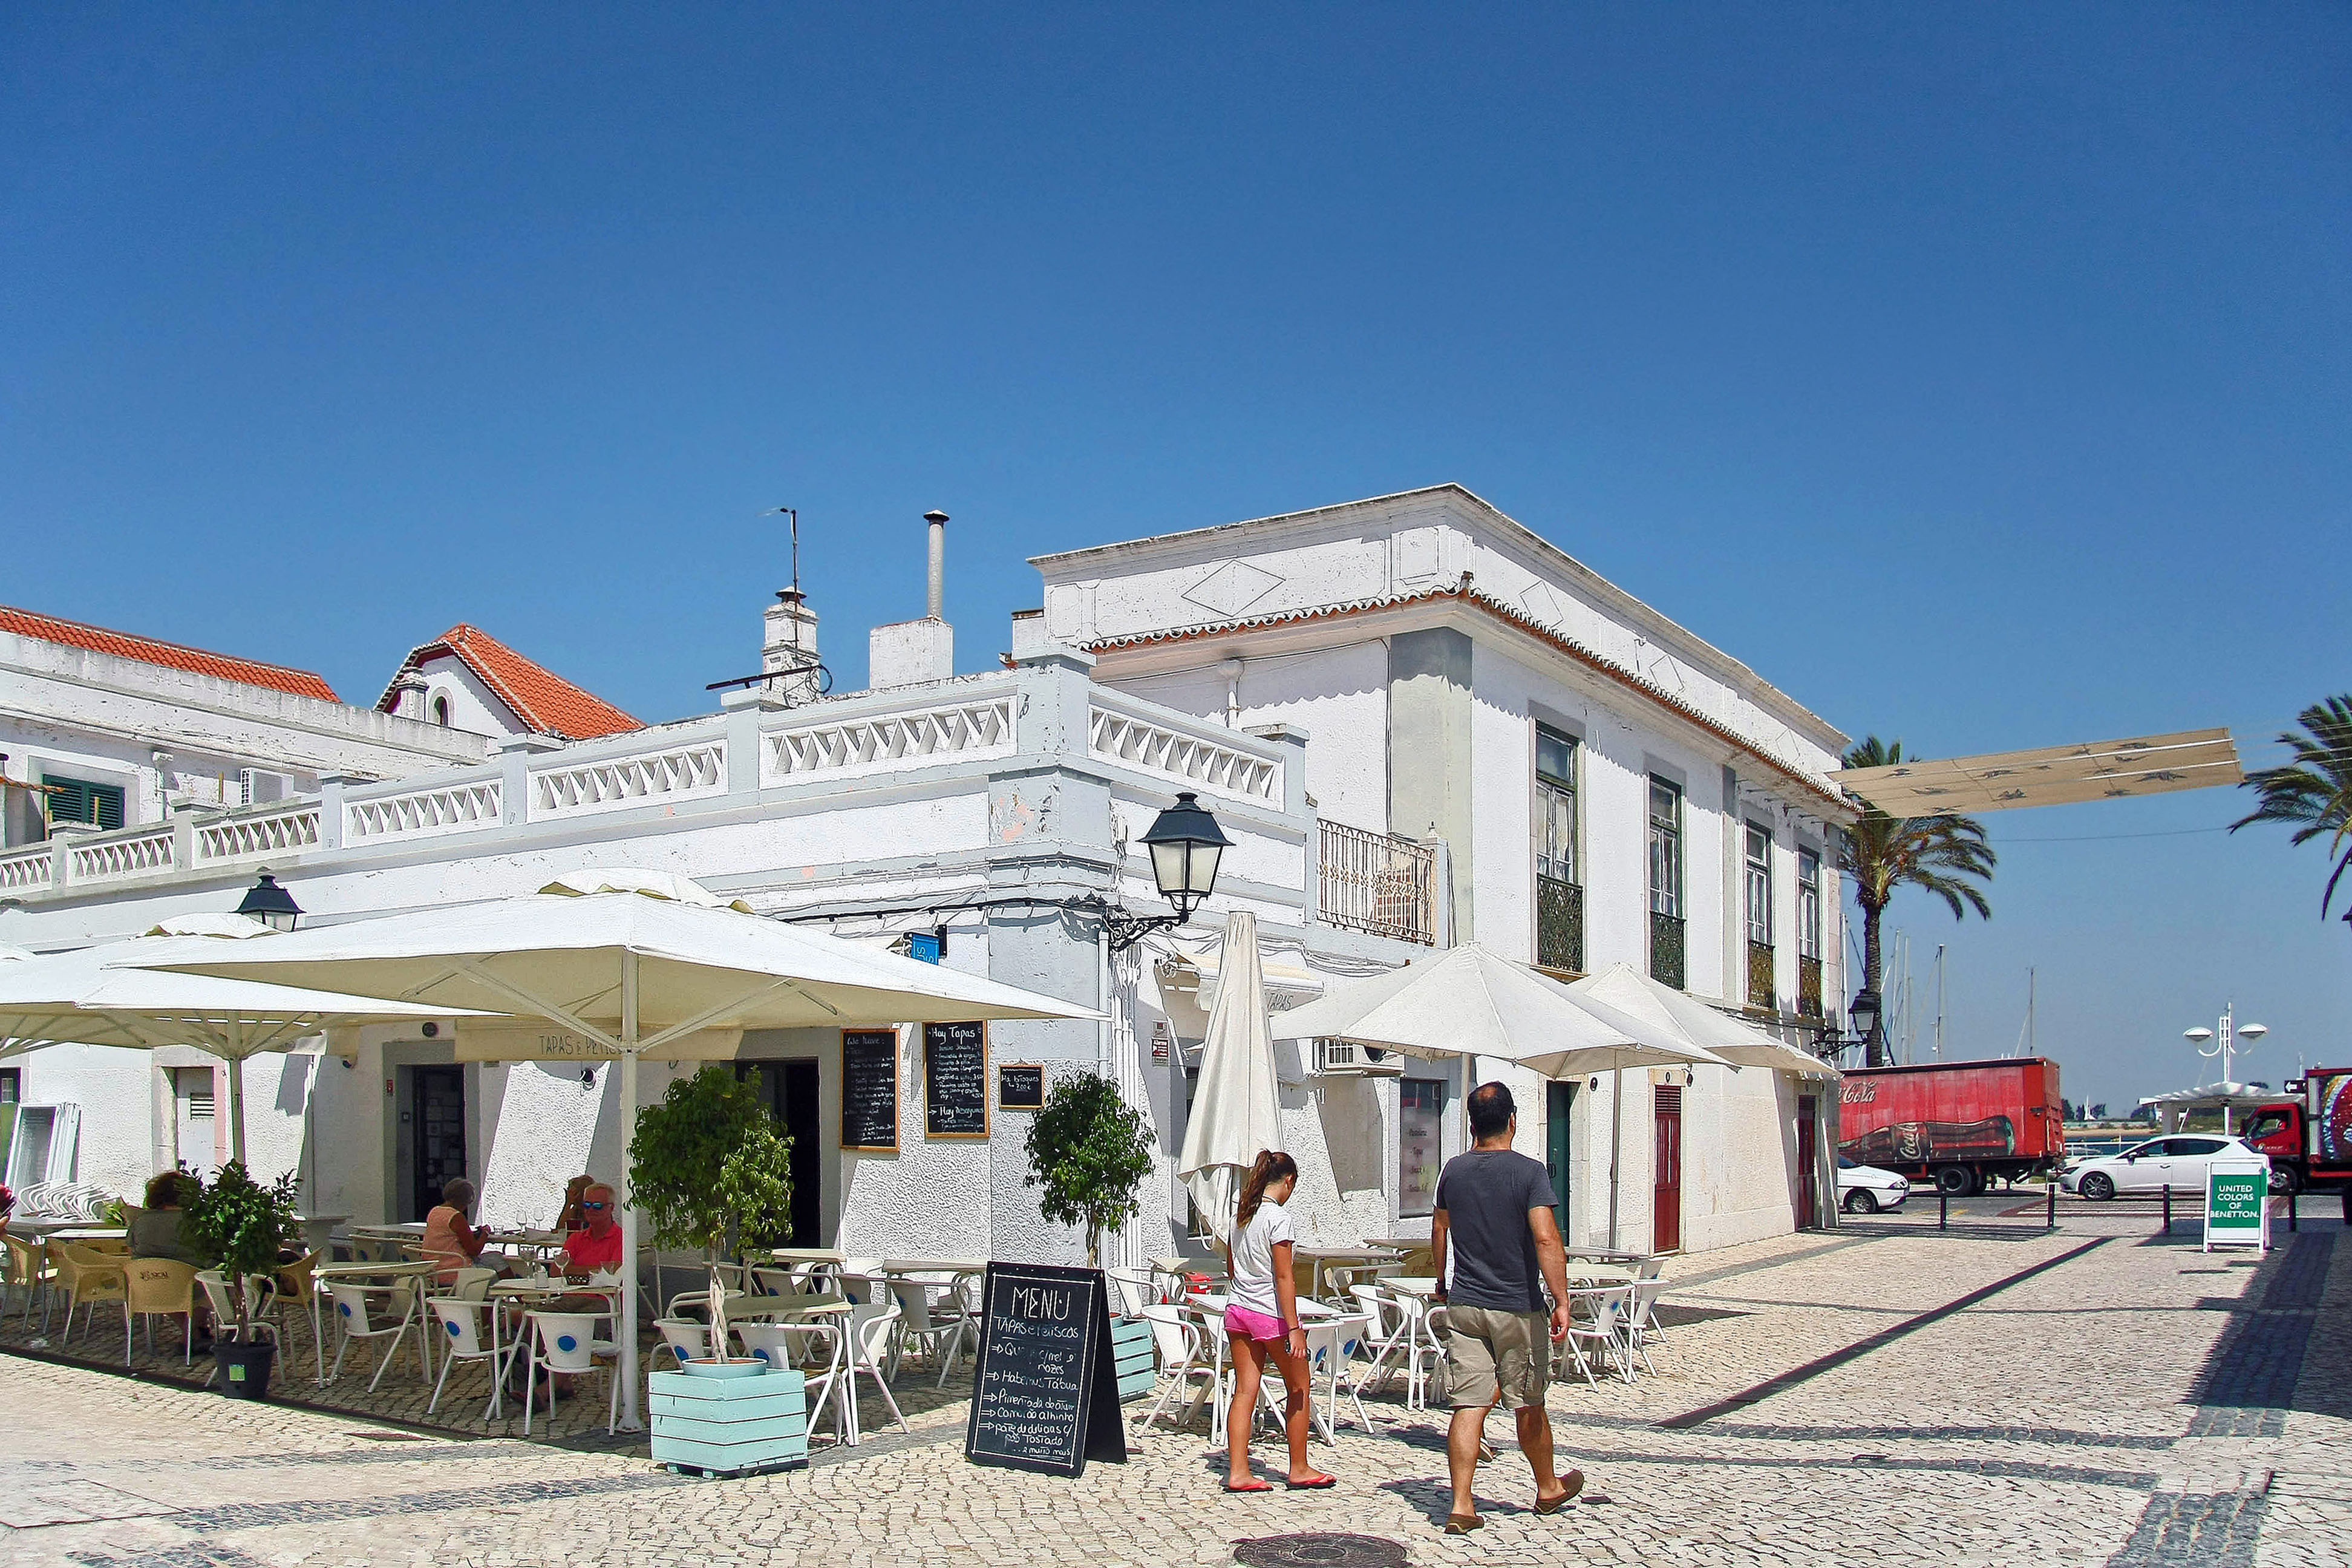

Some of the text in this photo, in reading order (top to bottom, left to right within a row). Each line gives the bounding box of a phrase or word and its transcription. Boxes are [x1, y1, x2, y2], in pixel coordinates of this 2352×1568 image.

[1267, 993, 1294, 1011] TAPAS
[539, 1034, 573, 1055] TAPAS
[932, 1025, 975, 1045] Hay Tapas
[1011, 1286, 1071, 1321] MENU
[993, 1315, 1027, 1335] TAPAS
